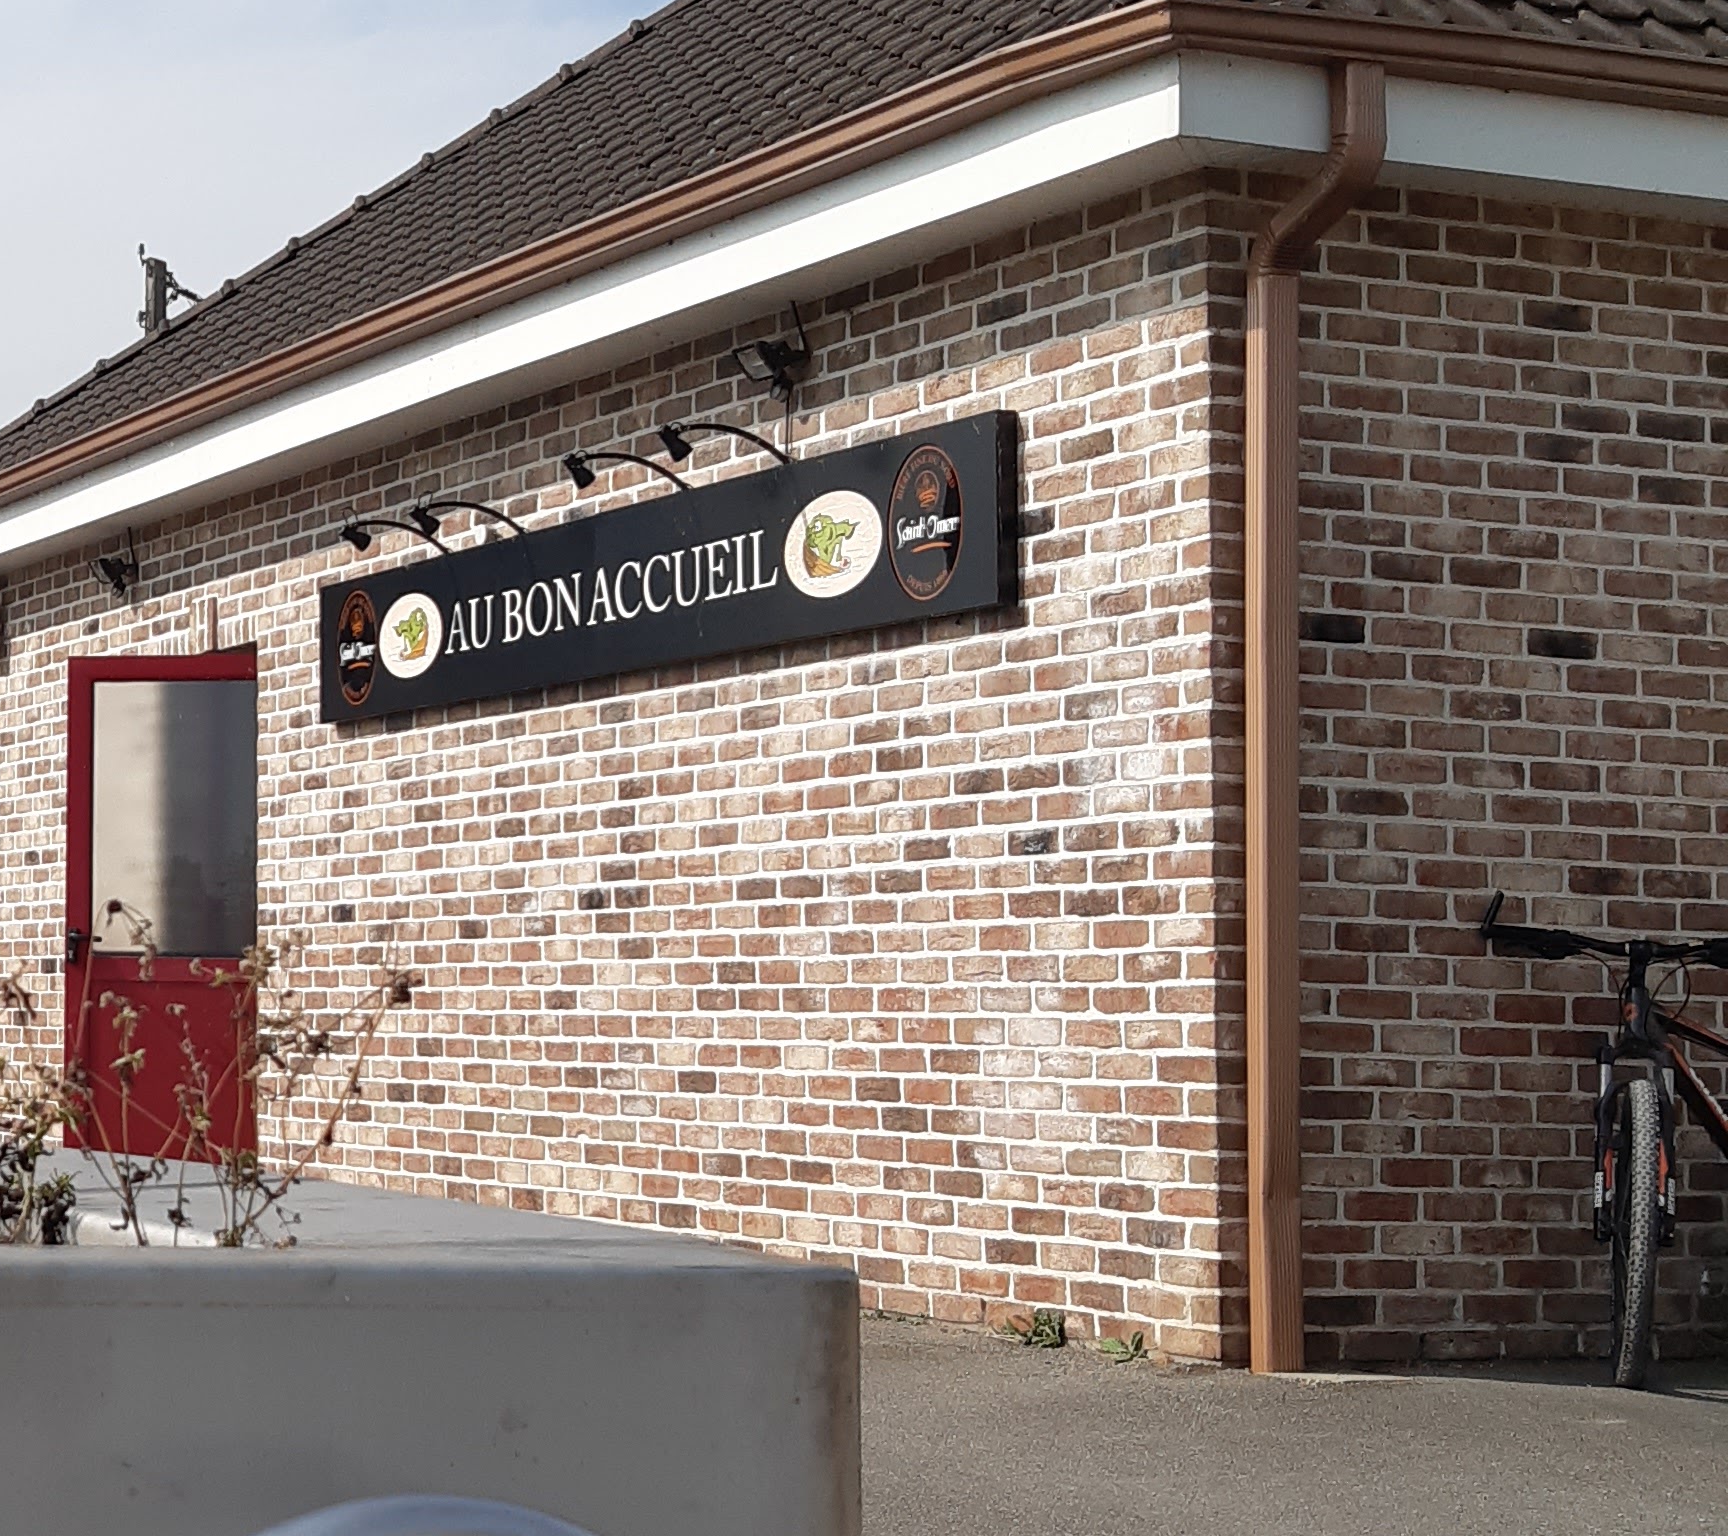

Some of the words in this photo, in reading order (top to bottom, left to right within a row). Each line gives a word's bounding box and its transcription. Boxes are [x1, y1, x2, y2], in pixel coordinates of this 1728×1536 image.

[445, 595, 494, 654] AU
[501, 571, 582, 644] BON
[586, 529, 778, 626] ACCUEIL
